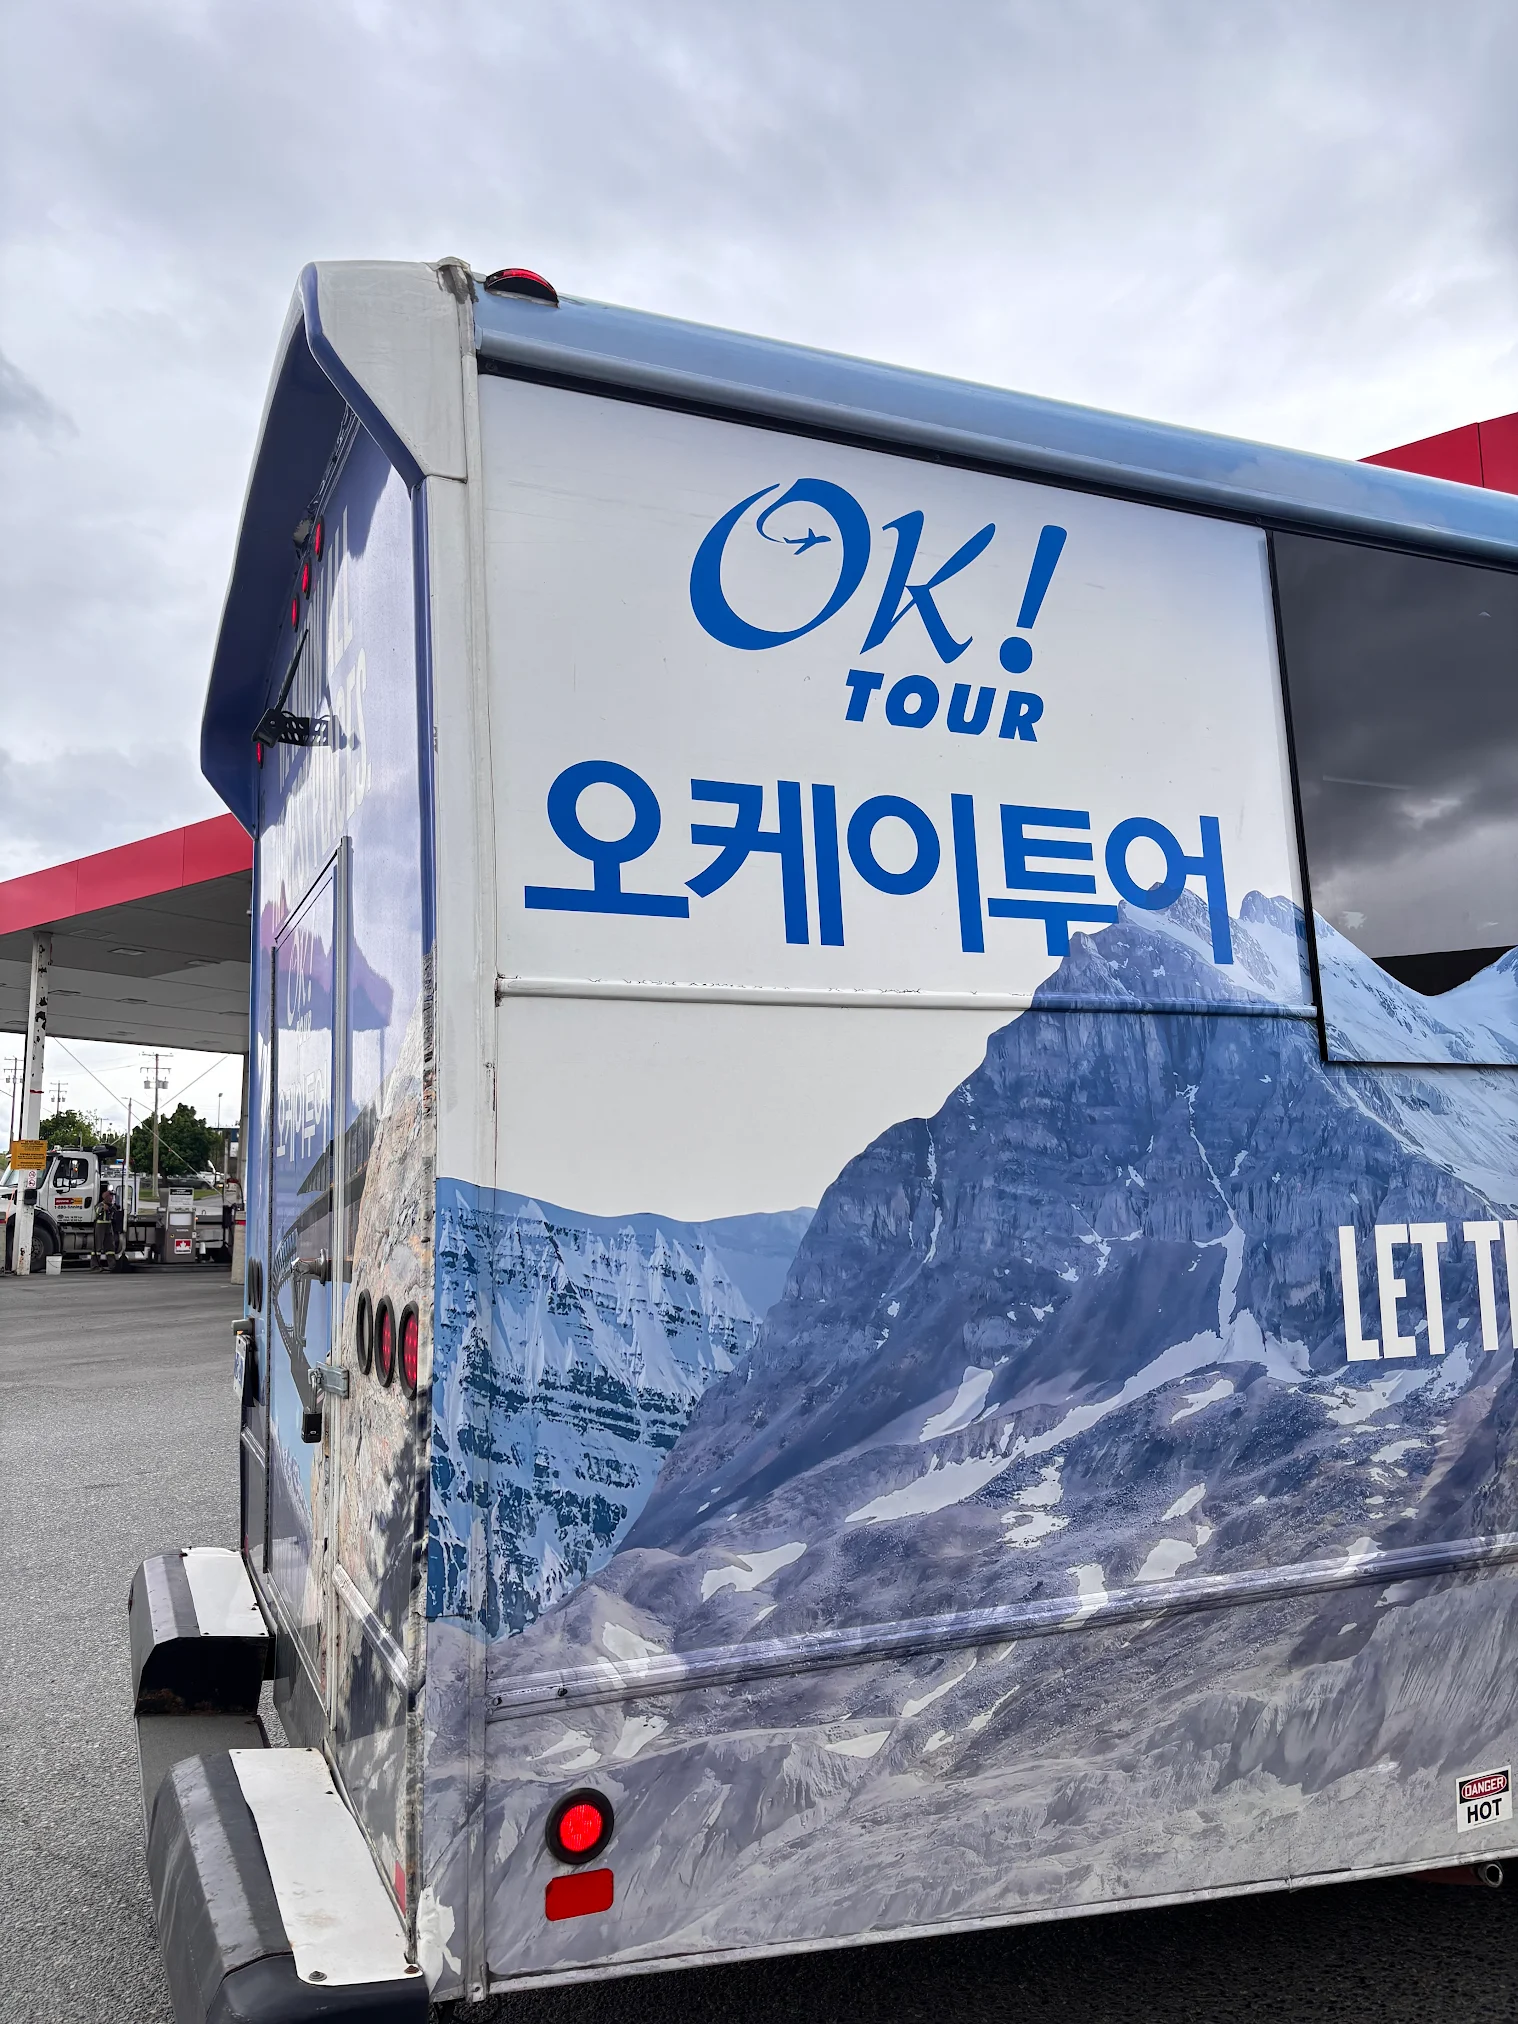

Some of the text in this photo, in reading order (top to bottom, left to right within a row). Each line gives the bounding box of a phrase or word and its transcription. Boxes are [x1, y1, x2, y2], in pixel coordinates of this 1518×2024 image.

[326, 505, 353, 688] ALL
[689, 477, 1068, 675] OK!
[845, 669, 1044, 742] TOUR
[285, 751, 310, 911] BEST
[312, 647, 372, 868] PLACES.
[524, 760, 1234, 964] 오케이투어
[276, 1059, 328, 1163] 오케이투어
[1339, 1222, 1448, 1361] LET
[1465, 1776, 1504, 1797] DANGER
[1467, 1798, 1502, 1824] HOT
